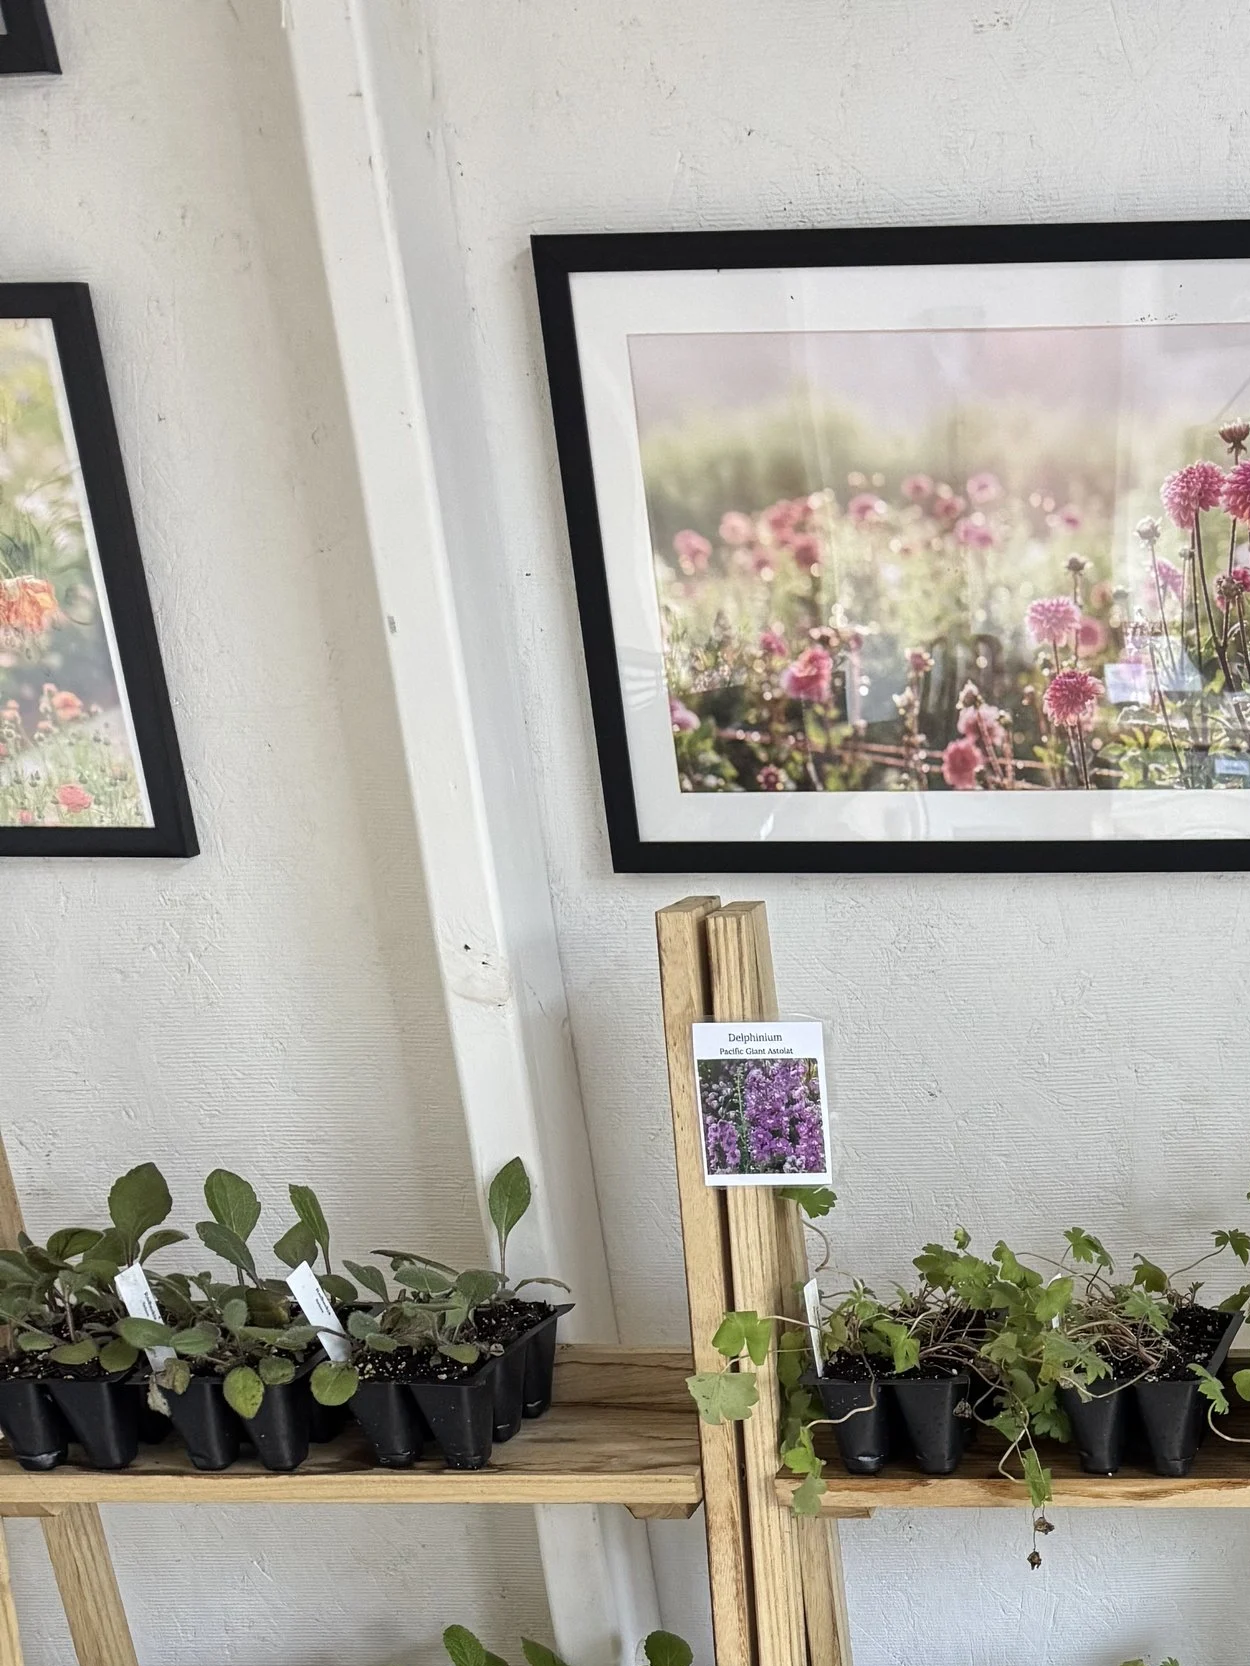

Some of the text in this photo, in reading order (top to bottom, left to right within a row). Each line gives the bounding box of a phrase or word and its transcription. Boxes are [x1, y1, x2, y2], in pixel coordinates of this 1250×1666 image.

[728, 1033, 783, 1044] Delphinium
[719, 1047, 794, 1055] Pacific Giant Astolat
